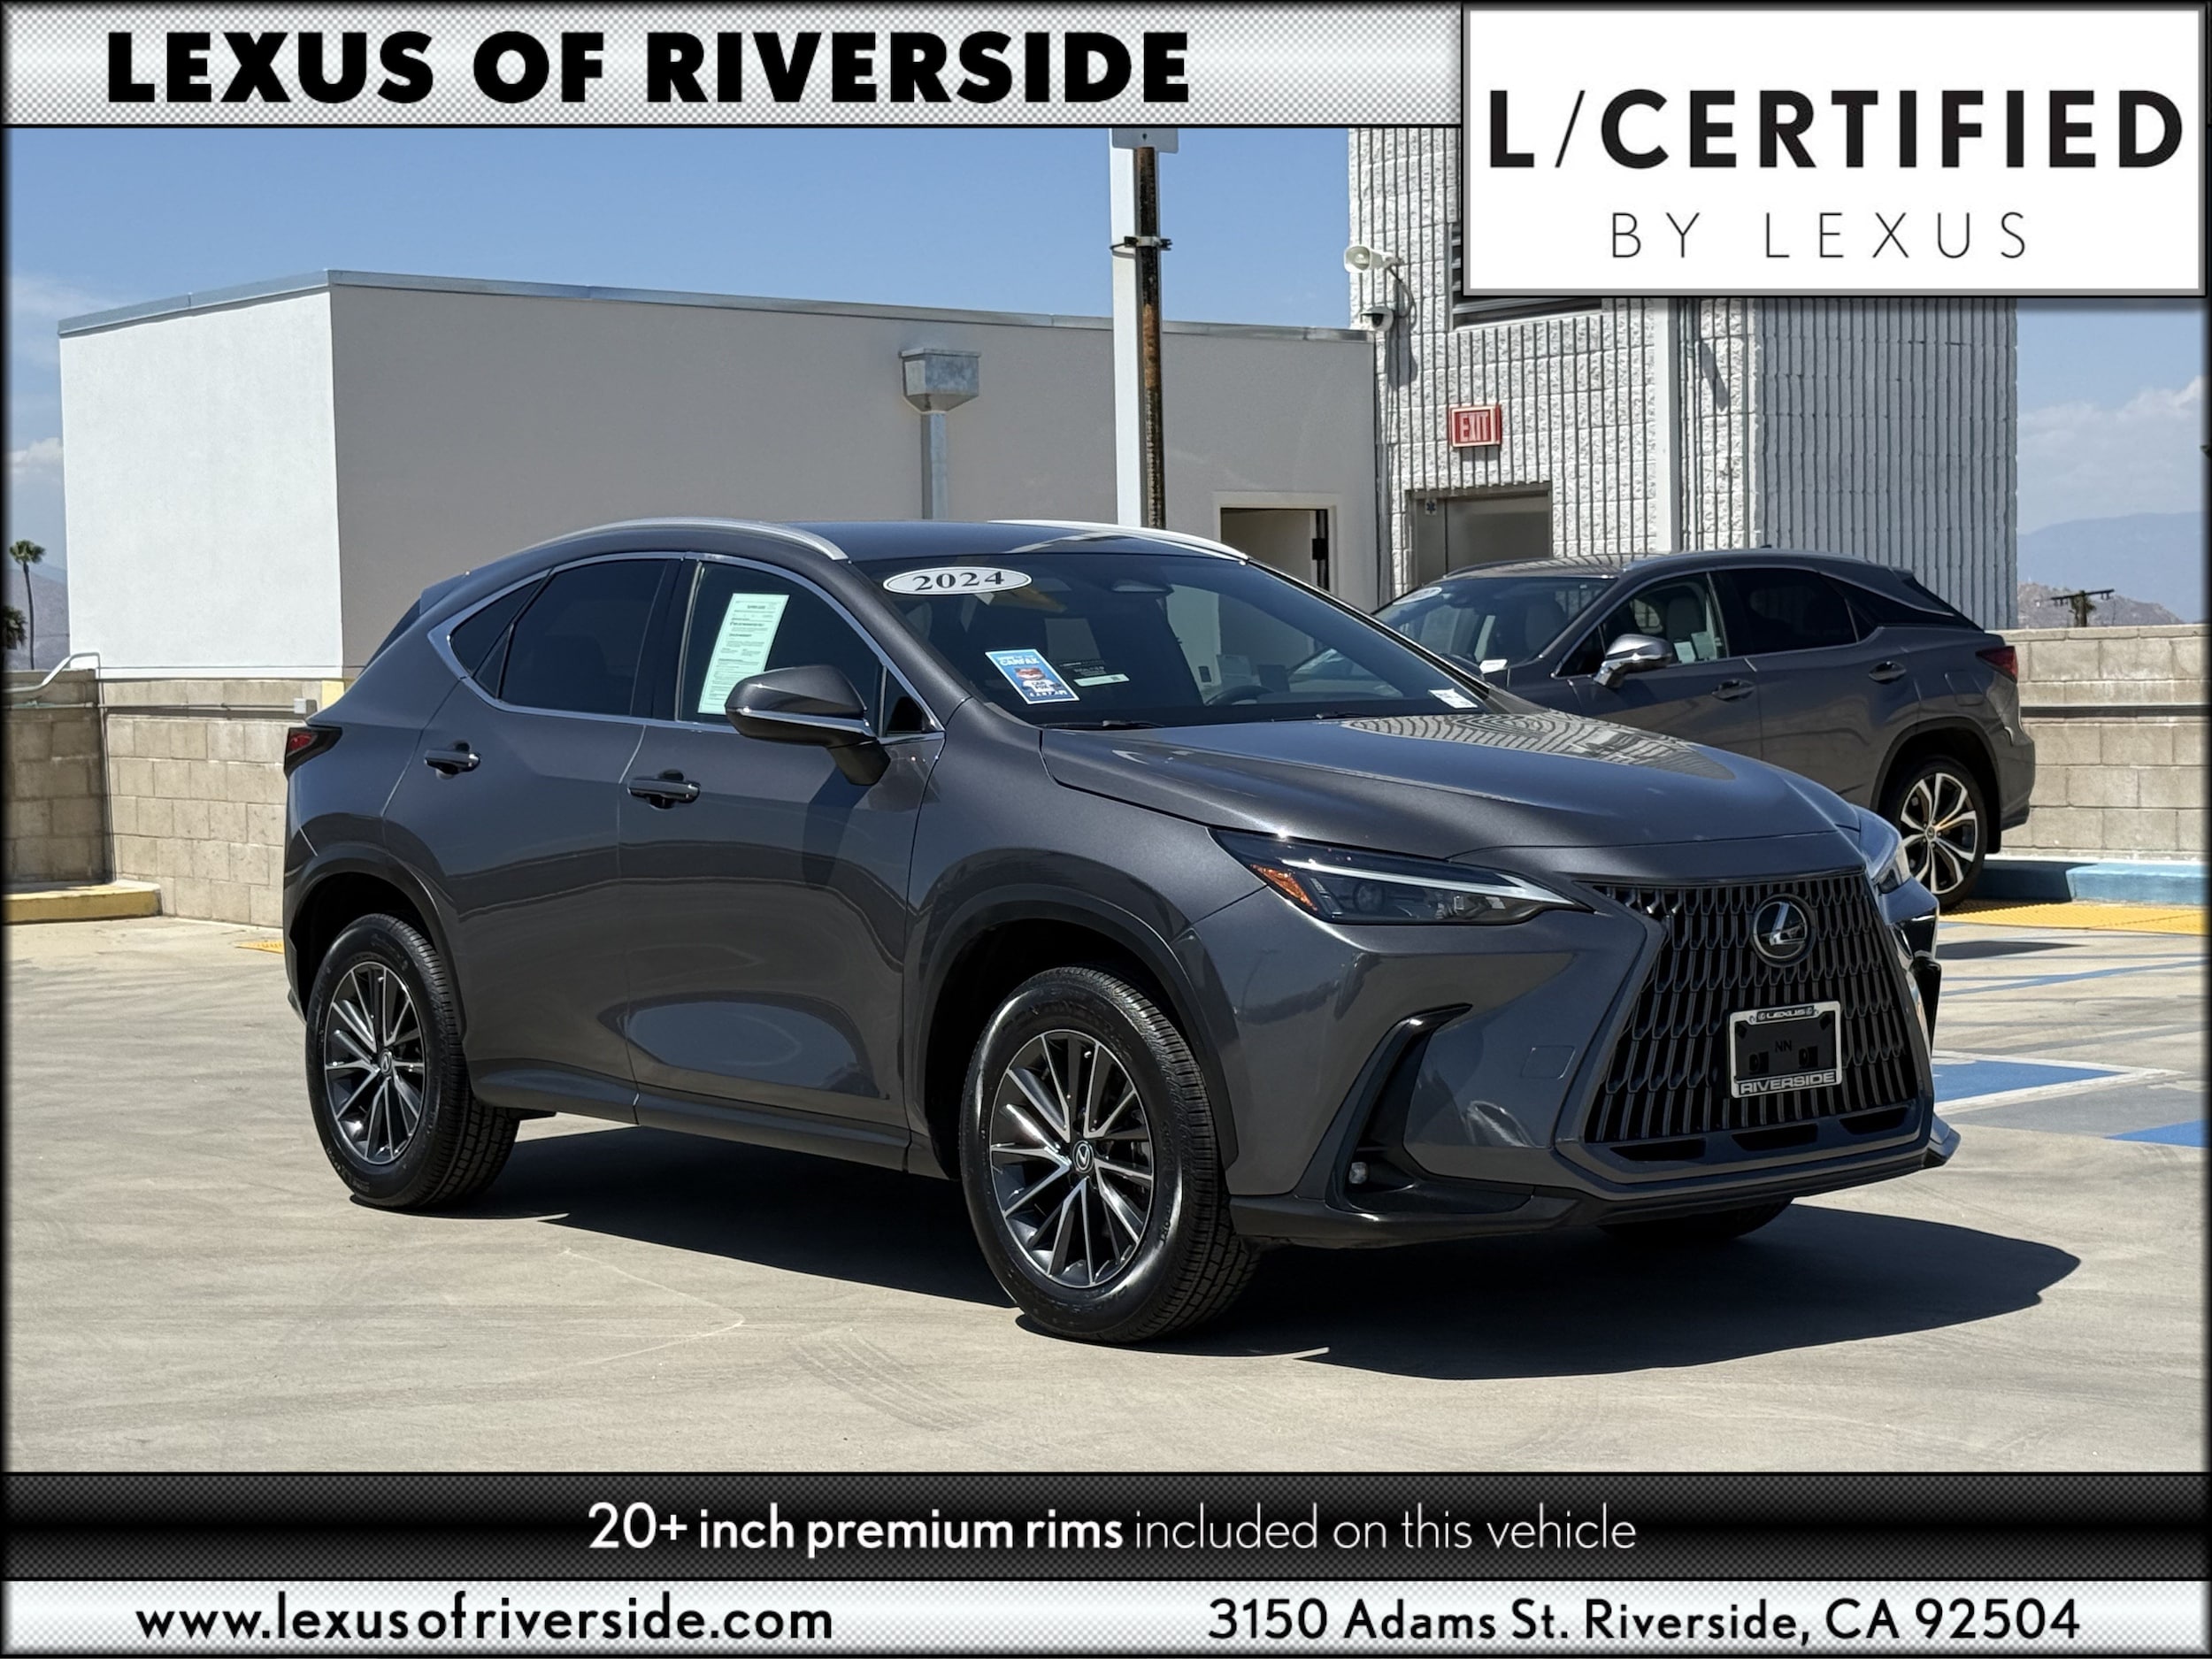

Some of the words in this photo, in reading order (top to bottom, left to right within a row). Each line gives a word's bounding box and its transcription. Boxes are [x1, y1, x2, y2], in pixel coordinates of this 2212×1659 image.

[1459, 411, 1489, 442] EXIT
[912, 571, 1004, 591] 2024
[1767, 1009, 1806, 1019] LEXUS
[1740, 1072, 1835, 1094] RIVERSIDE
